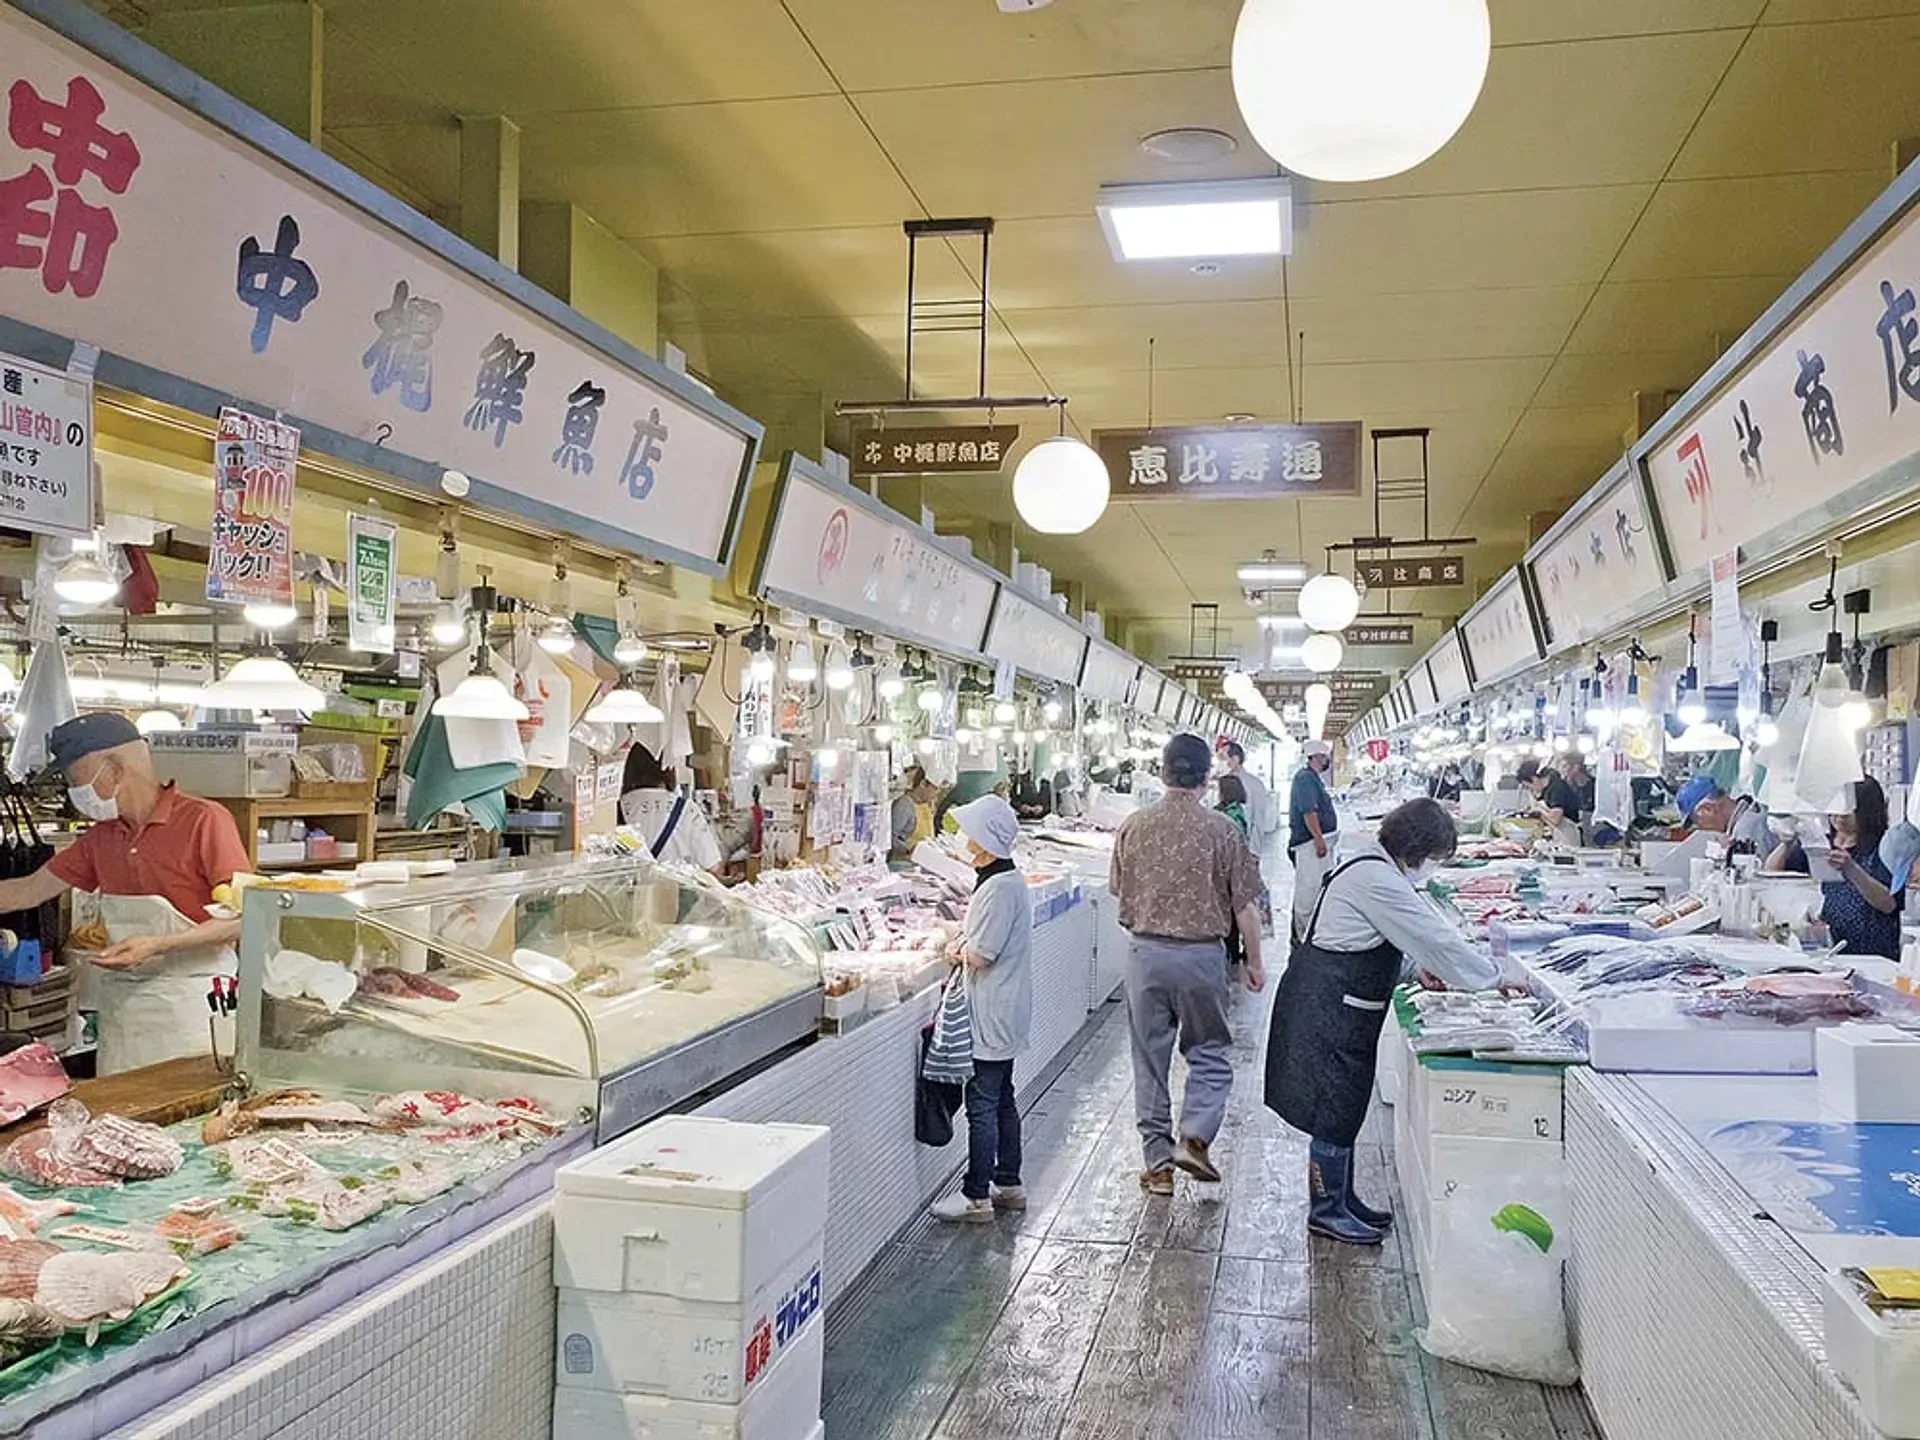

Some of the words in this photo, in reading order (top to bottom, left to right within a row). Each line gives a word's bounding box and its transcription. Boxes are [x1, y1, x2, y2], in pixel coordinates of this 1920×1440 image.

[236, 214, 668, 500] 中梶鮮魚店
[892, 441, 1000, 464] 中梶鮮魚店
[1128, 439, 1323, 486] 恵比寿通
[1533, 1117, 1549, 1138] 12
